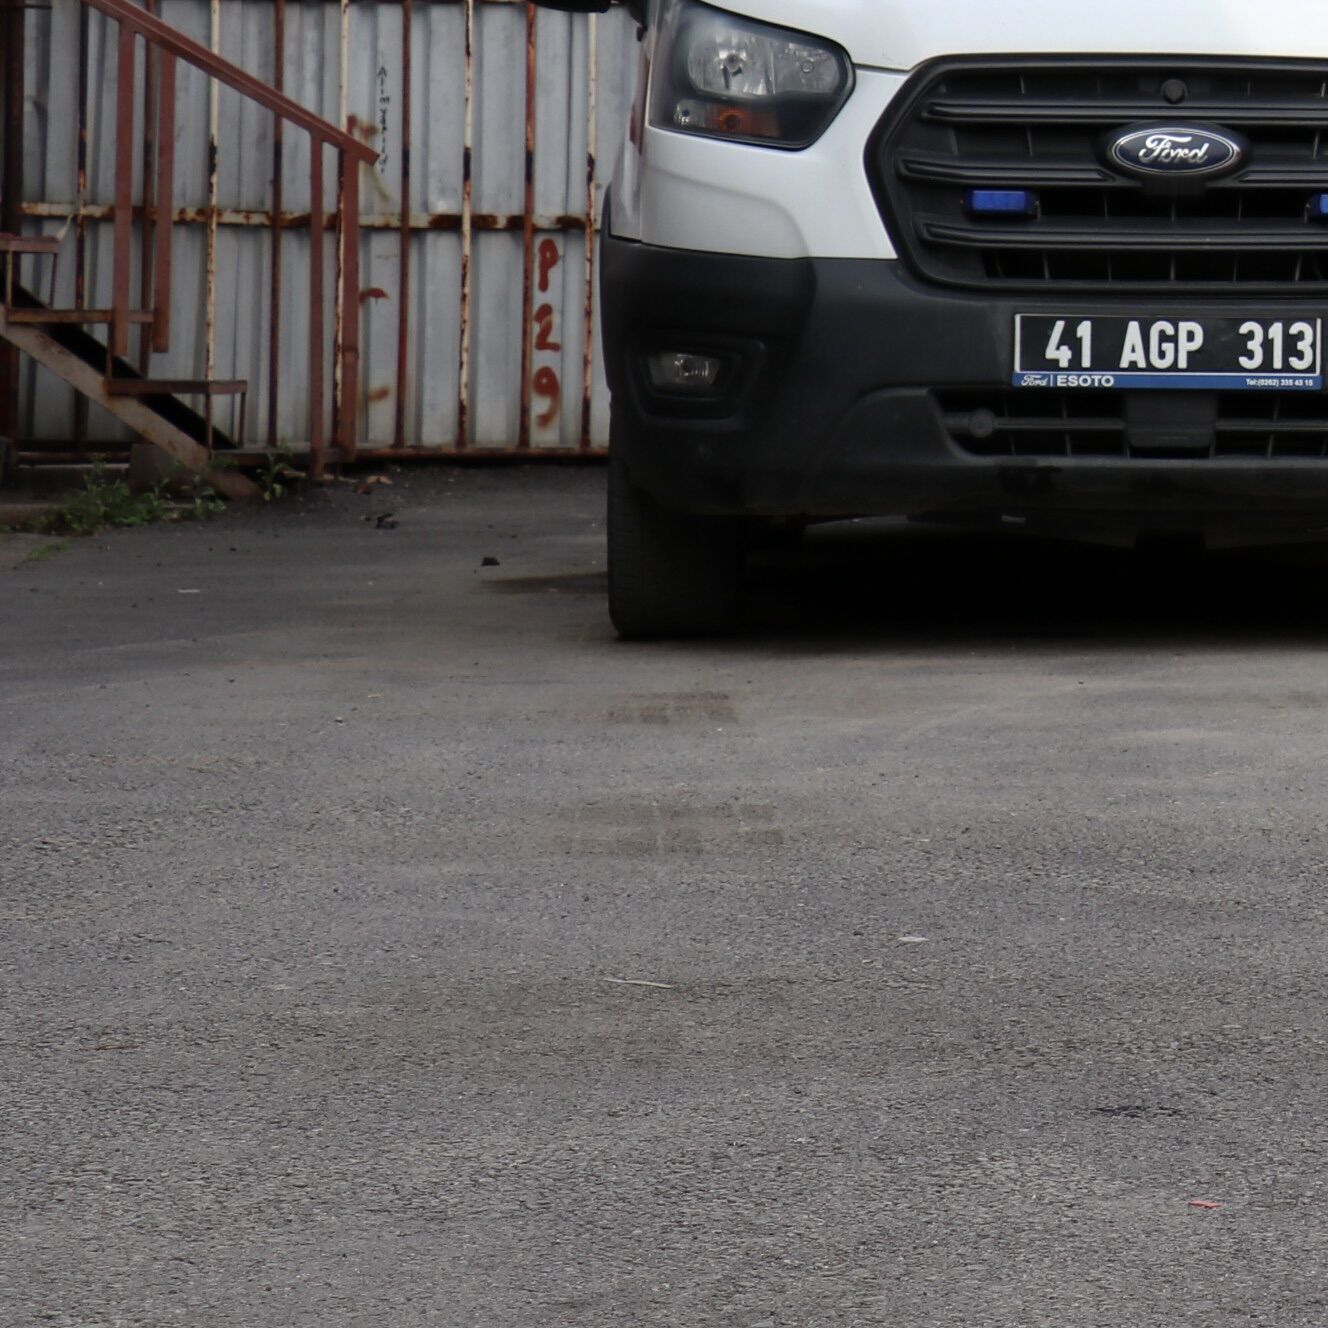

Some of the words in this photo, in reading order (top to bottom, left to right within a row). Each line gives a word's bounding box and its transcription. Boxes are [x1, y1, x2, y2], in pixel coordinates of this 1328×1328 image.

[1139, 135, 1209, 159] Ford
[1045, 320, 1092, 368] 41
[1119, 321, 1203, 369] AGP
[1238, 321, 1314, 370] 313
[1020, 375, 1048, 386] Ford
[1057, 375, 1114, 387] ESOTO
